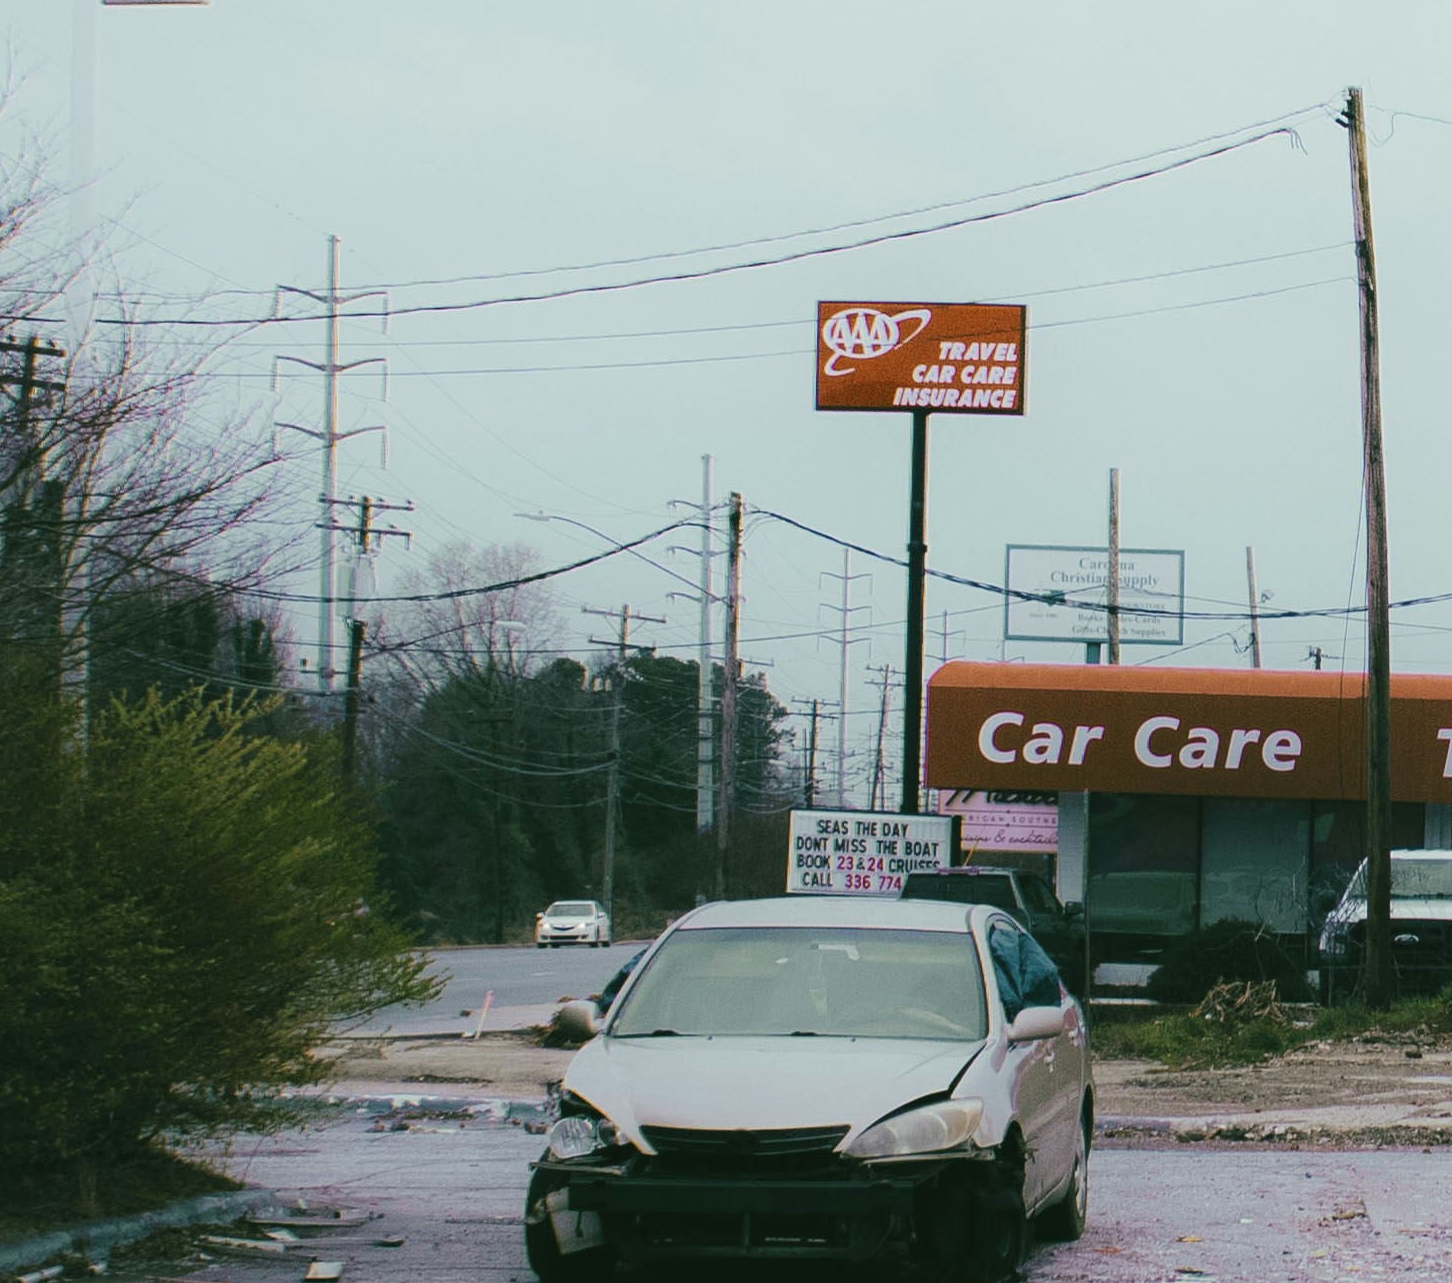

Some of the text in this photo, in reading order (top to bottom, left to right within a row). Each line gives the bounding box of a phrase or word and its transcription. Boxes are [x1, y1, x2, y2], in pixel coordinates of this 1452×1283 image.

[825, 309, 898, 358] AAA
[938, 341, 1018, 362] TRAVEL
[912, 363, 1017, 385] CAR CARE
[892, 386, 1017, 409] INSURANCE
[1078, 557, 1135, 571] Carona
[977, 711, 1304, 772] Car Care
[816, 819, 909, 838] SEAS THE DAY
[796, 836, 940, 858] DONT MISS THE BOAT
[797, 854, 831, 869] BOOK
[802, 871, 903, 891] CALL 336 774
